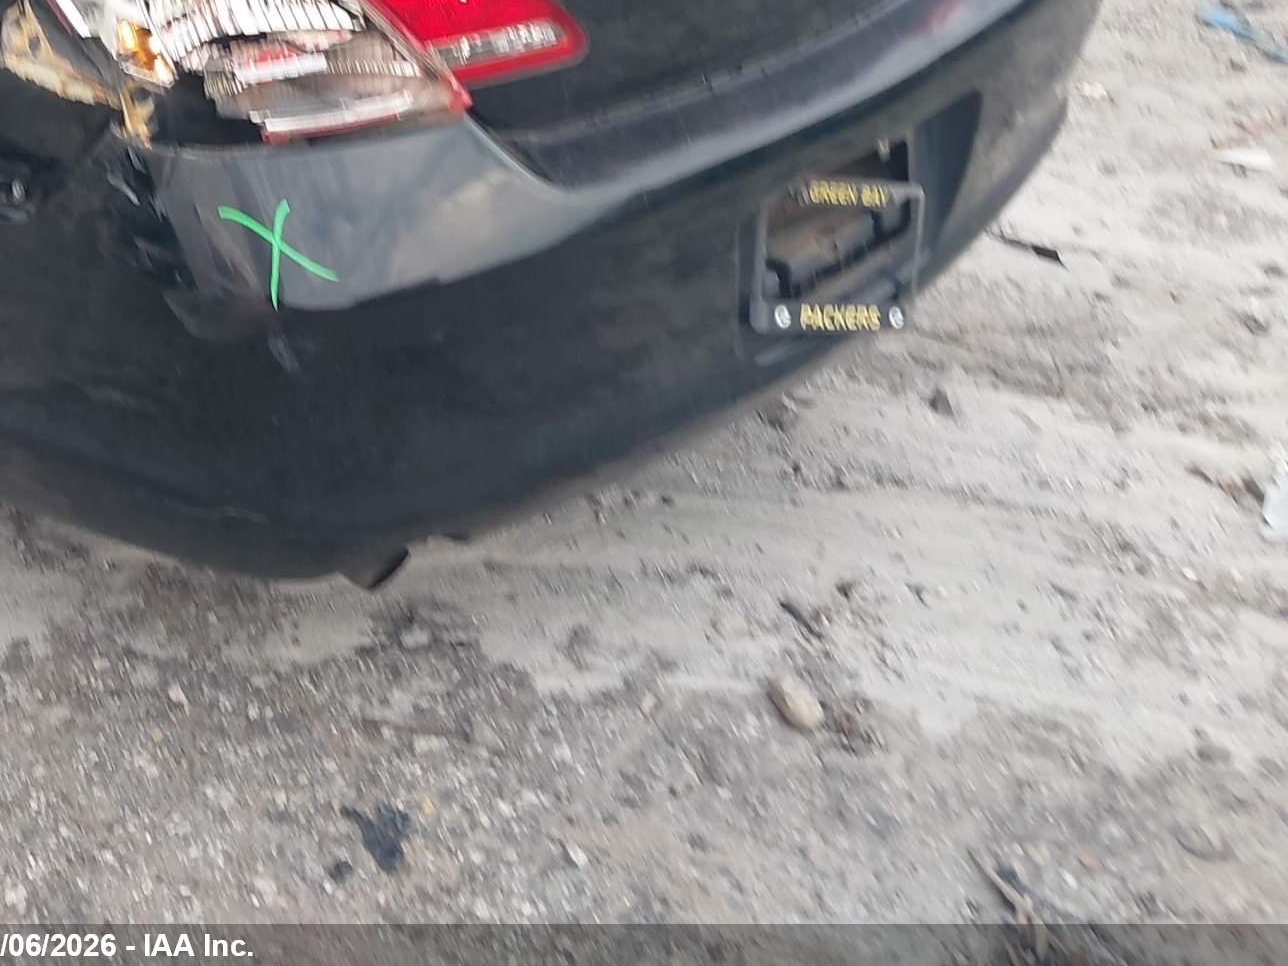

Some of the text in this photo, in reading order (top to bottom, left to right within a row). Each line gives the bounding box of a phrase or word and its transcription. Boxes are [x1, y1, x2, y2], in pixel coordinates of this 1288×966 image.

[808, 180, 889, 208] GREEN BAY
[799, 303, 881, 331] PACKERS
